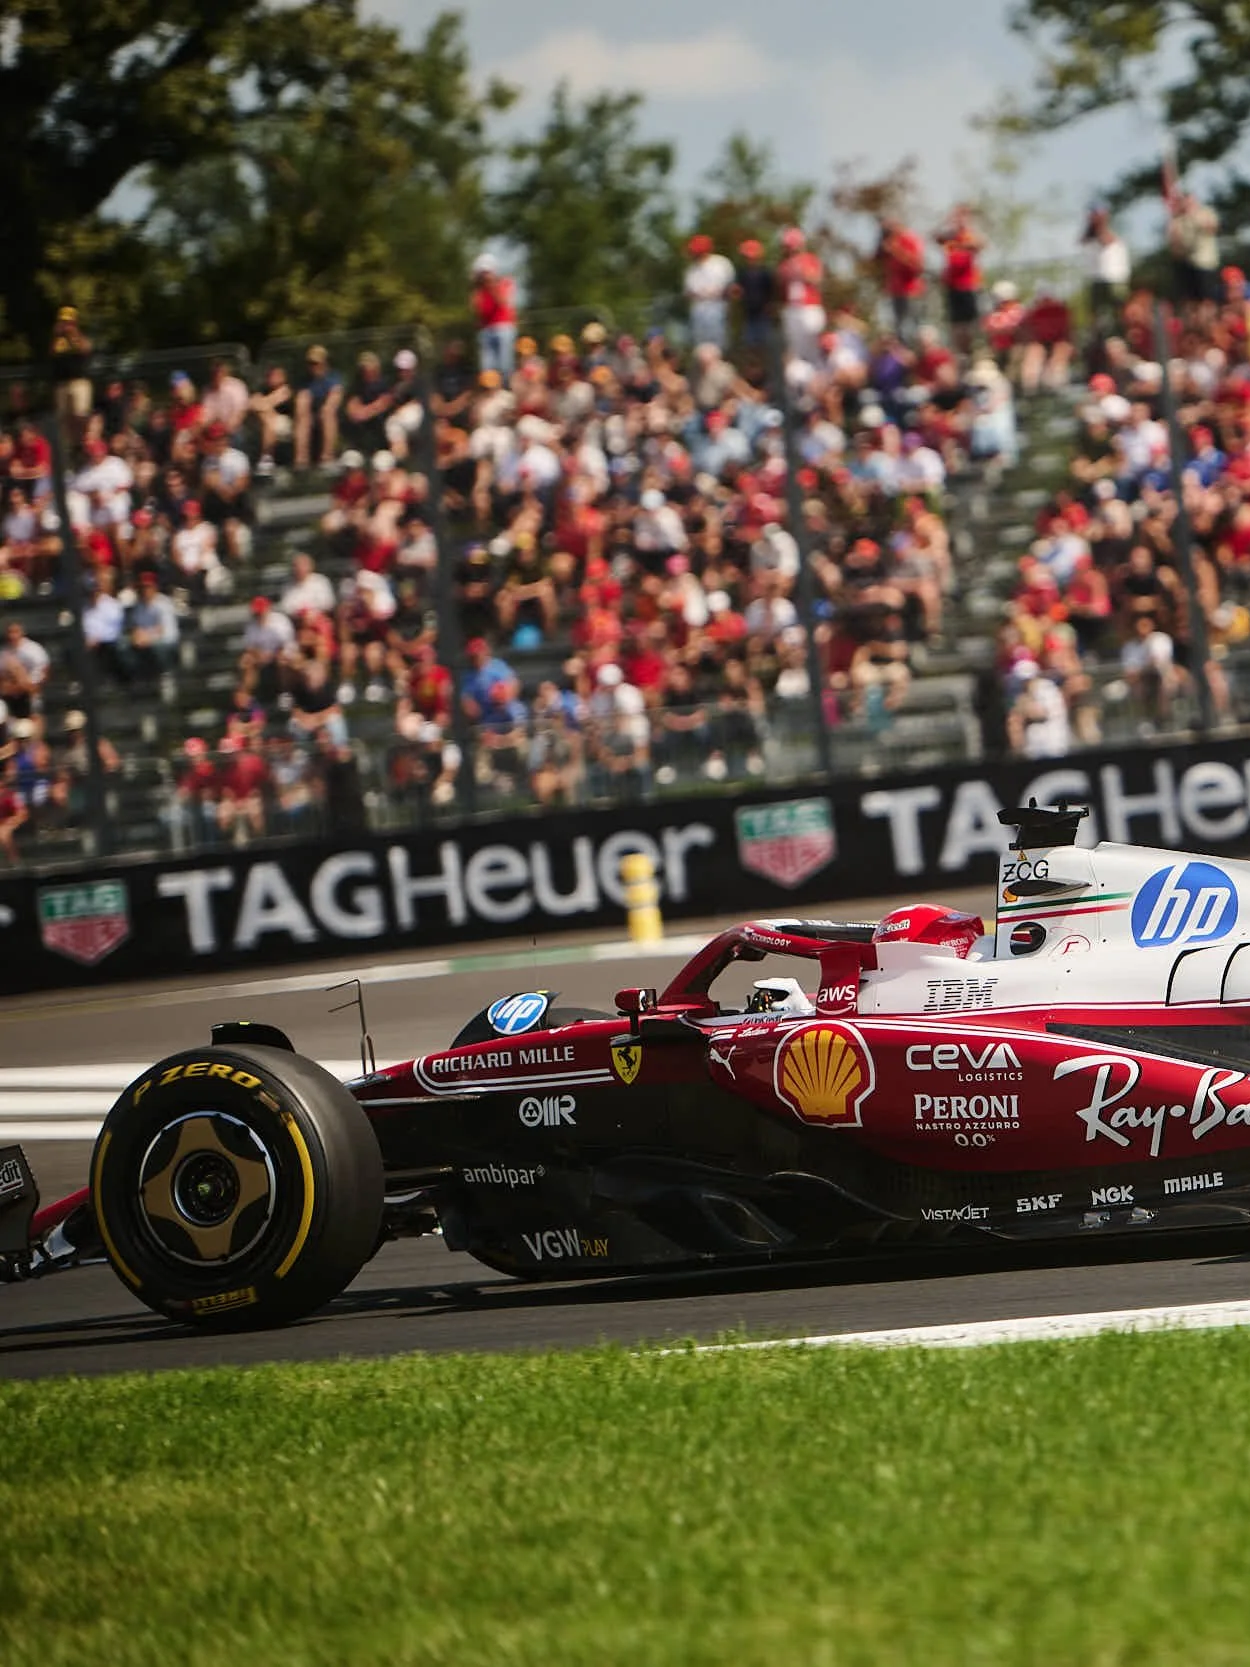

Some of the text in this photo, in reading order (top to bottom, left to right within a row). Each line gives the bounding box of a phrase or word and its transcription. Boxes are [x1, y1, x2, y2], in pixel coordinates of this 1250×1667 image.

[1002, 859, 1049, 883] ZCG
[1136, 862, 1235, 947] hp
[817, 984, 856, 1004] aws
[923, 978, 999, 1012] IBM
[431, 1046, 575, 1074] RICHARD MILLE
[160, 1062, 262, 1089] ZERO
[958, 1072, 1023, 1082] LOGISTICS
[914, 1093, 1019, 1120] PERONI
[916, 1121, 1020, 1131] NASTRO AZZURRO
[1091, 1184, 1135, 1206] NGK
[1163, 1172, 1224, 1194] MAHLE
[1016, 1193, 1063, 1213] SKF
[522, 1229, 582, 1261] VGW
